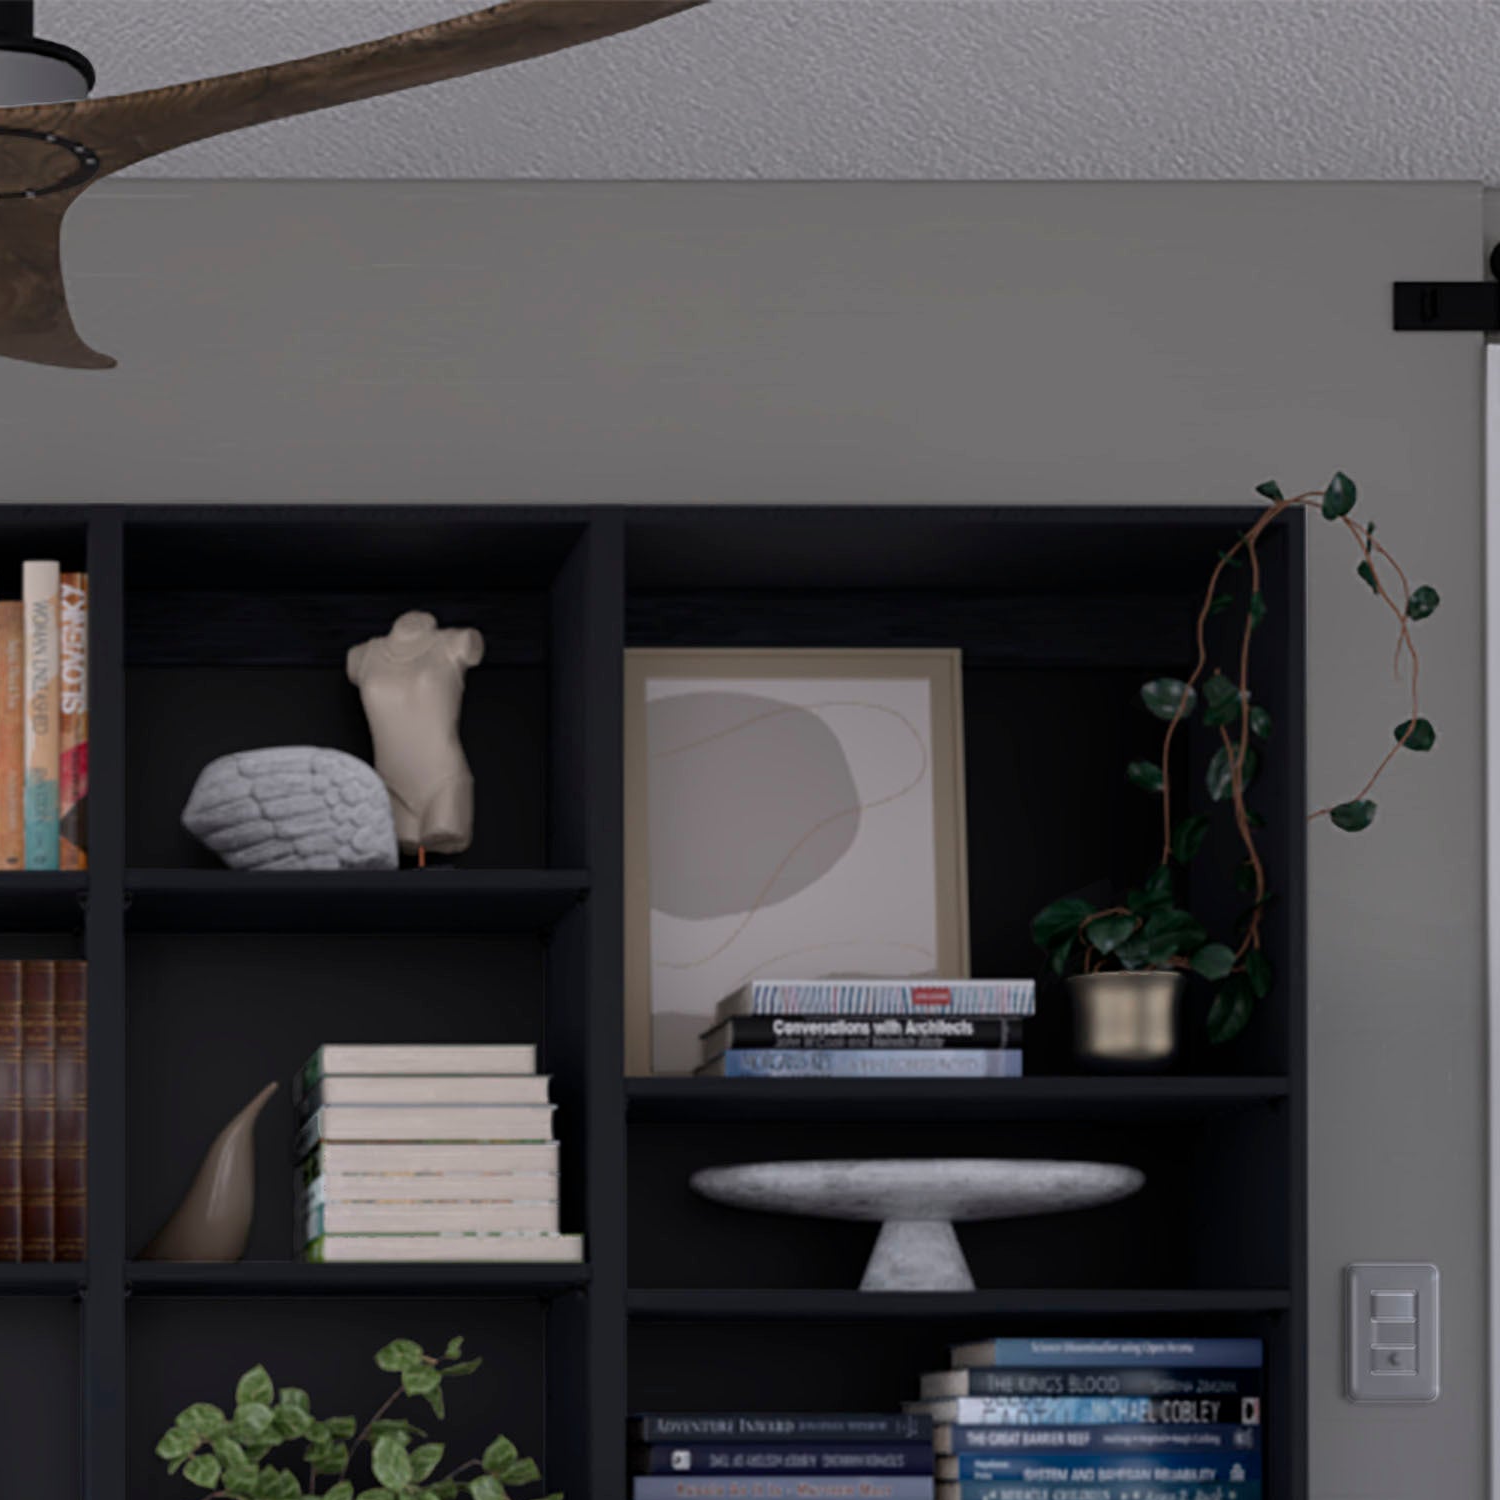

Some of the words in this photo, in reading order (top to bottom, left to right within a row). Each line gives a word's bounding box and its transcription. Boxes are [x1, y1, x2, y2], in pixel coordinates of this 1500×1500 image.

[773, 1020, 870, 1037] Conversations
[873, 1020, 902, 1037] with
[905, 1020, 974, 1037] Architects
[988, 1375, 1015, 1394] THE
[1068, 1375, 1120, 1394] BLOOD
[1159, 1400, 1221, 1422] COBLEY
[967, 1432, 985, 1446] THE
[987, 1432, 1021, 1446] GREAT
[1022, 1432, 1064, 1446] BARRIER
[1067, 1432, 1091, 1446] REEF
